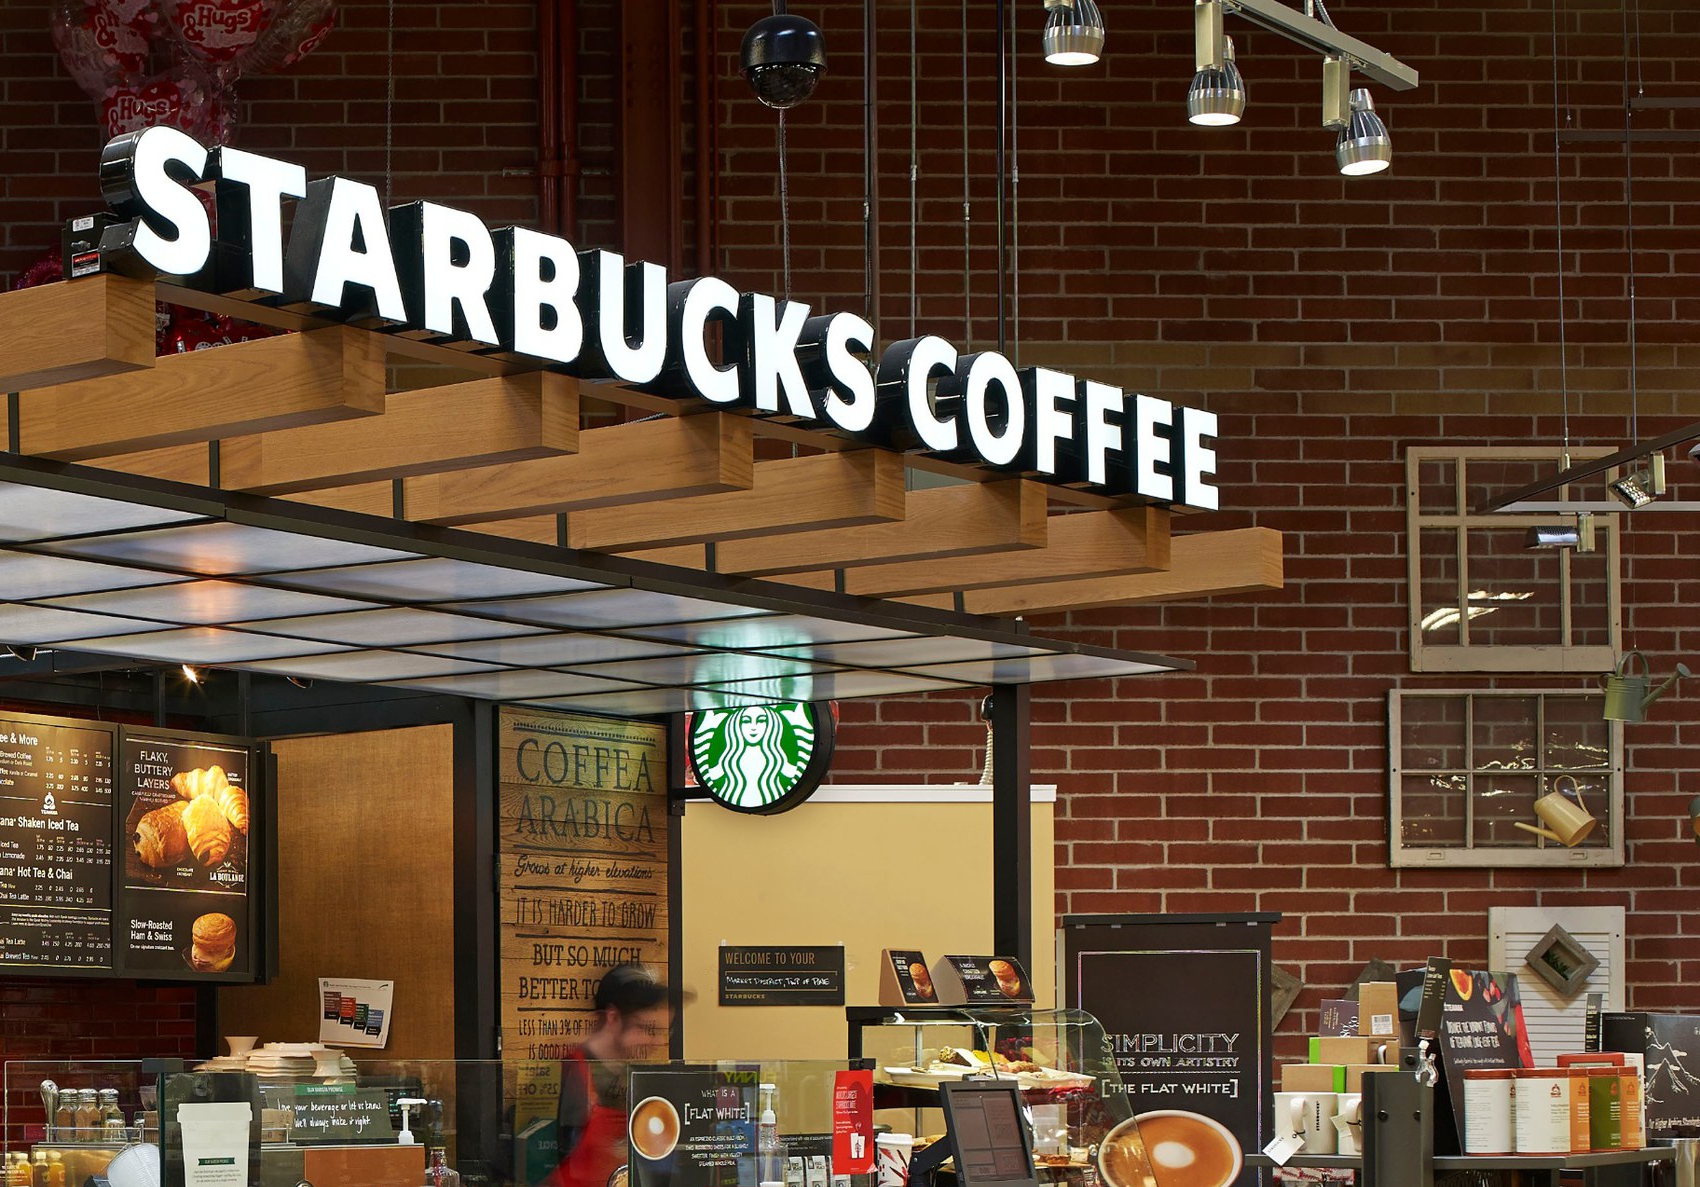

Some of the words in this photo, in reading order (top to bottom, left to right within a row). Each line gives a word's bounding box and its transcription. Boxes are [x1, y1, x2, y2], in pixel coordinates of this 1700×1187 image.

[199, 7, 249, 36] Hugs
[120, 97, 168, 123] Hugs
[134, 126, 875, 433] STARBUCKS
[906, 336, 1220, 511] COFFEE
[10, 733, 17, 743] &
[19, 734, 38, 745] More
[140, 751, 168, 764] FLAKY,
[516, 738, 655, 792] COFFEA
[134, 764, 173, 777] BUTTERY
[137, 778, 170, 790] LAYERS
[18, 816, 46, 829] Shaken
[48, 819, 64, 830] Iced
[66, 820, 79, 831] Tea
[516, 794, 656, 843] ARABICA
[17, 865, 31, 877] Hot
[33, 867, 45, 878] Tea
[47, 868, 54, 879] &
[56, 869, 73, 880] Chai
[514, 854, 550, 877] Grows
[555, 863, 567, 874] at
[570, 859, 600, 883] higher
[606, 862, 652, 879] elevations
[210, 872, 217, 881] LA
[516, 897, 528, 924] IT
[533, 898, 543, 924] IS
[549, 899, 596, 926] HARDER
[602, 901, 616, 927] TO
[622, 902, 656, 929] GROW
[131, 919, 173, 930] Slow-Roasted
[131, 931, 145, 941] Ham
[147, 931, 153, 940] &
[154, 932, 172, 942] Swiss
[533, 943, 564, 966] BUT
[567, 945, 589, 967] SO
[593, 946, 641, 967] MUCH
[725, 952, 771, 965] WELCOME
[775, 952, 786, 965] TO
[790, 952, 815, 965] YOUR
[519, 977, 580, 1000] BETTER
[1101, 1033, 1240, 1053] SIMPLICITY
[1116, 1057, 1136, 1067] ITS
[1140, 1057, 1171, 1067] OWN
[1176, 1057, 1240, 1067] ARTISTRY
[701, 1090, 719, 1098] WHAT
[721, 1089, 728, 1097] IS
[730, 1089, 736, 1097] A
[1141, 1083, 1179, 1094] FLAT
